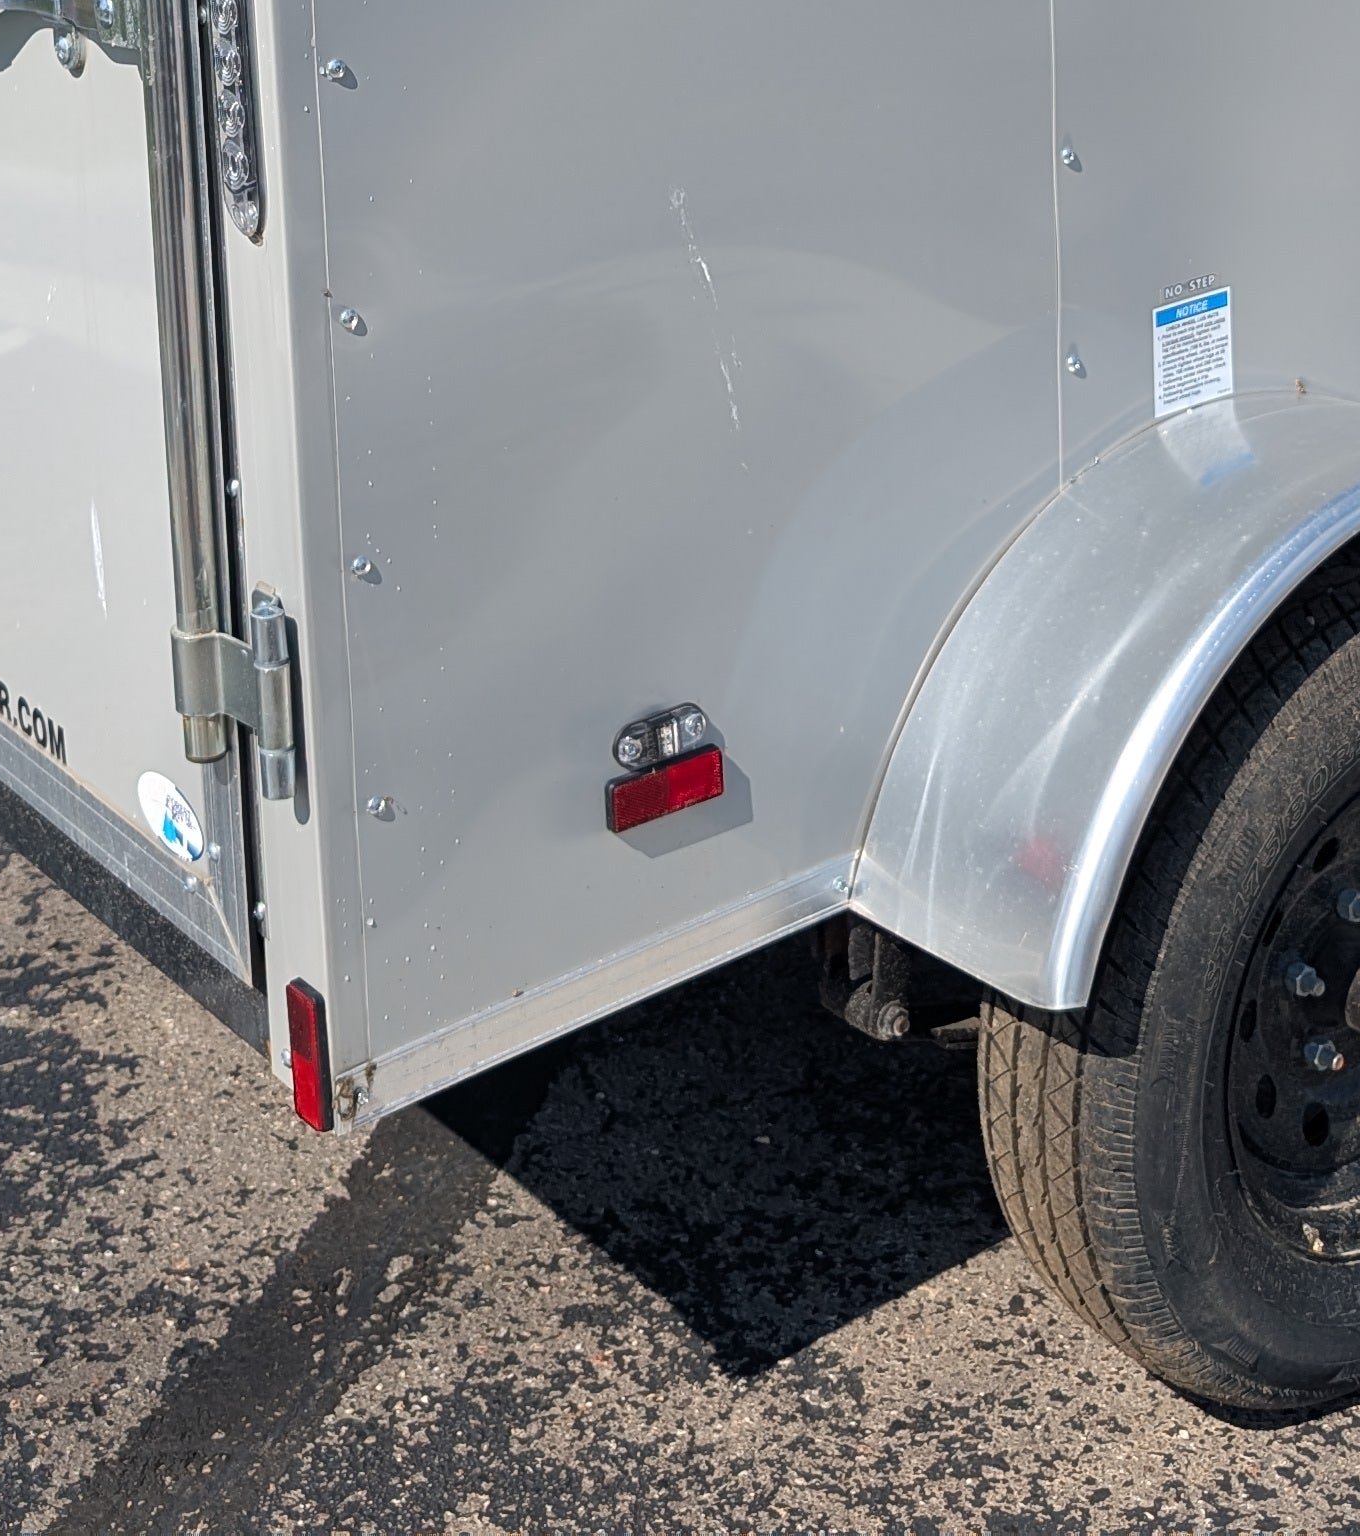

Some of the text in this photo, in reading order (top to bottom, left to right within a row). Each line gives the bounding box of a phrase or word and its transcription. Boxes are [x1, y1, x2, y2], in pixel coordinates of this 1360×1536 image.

[1164, 274, 1216, 299] NO STEP
[1175, 299, 1208, 318] NOTICE
